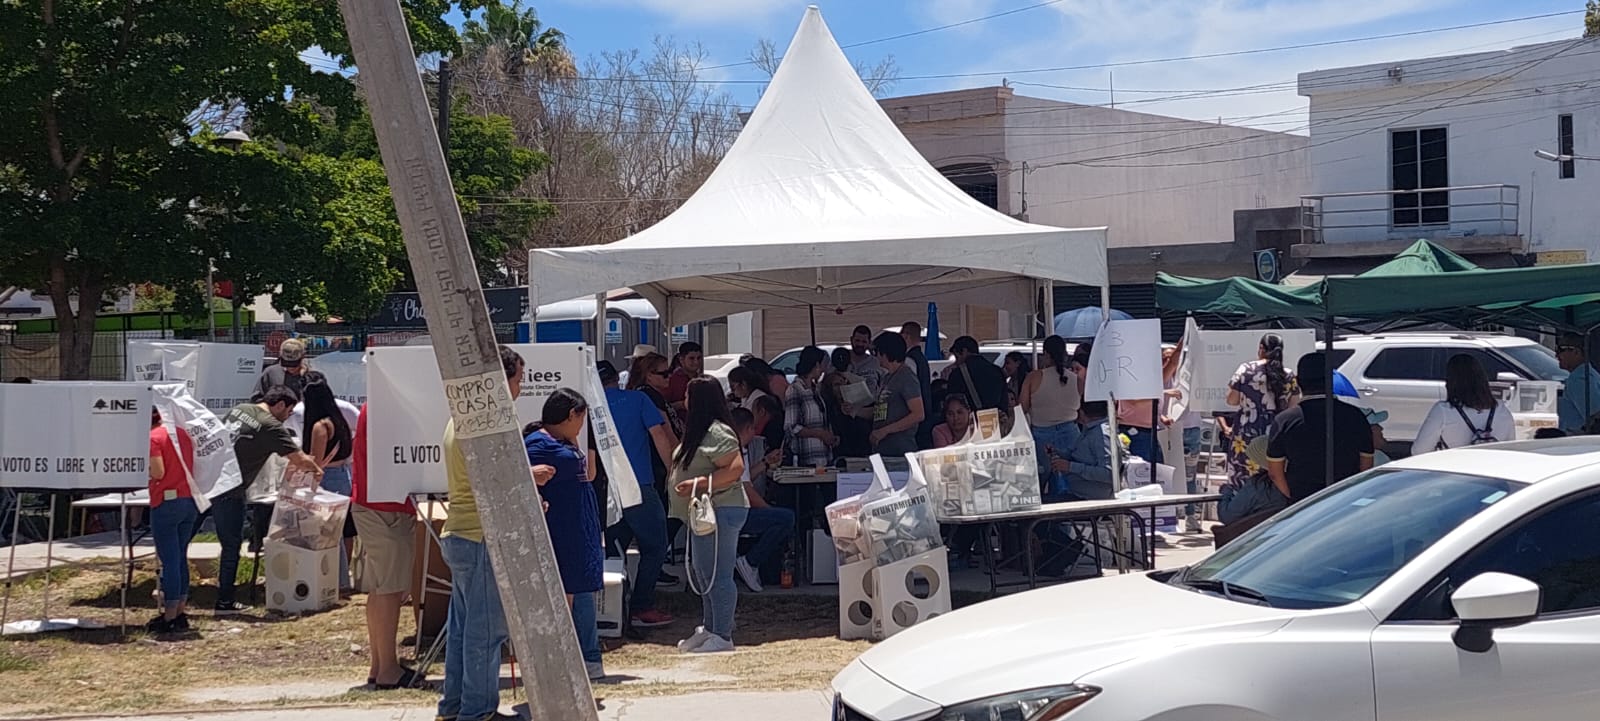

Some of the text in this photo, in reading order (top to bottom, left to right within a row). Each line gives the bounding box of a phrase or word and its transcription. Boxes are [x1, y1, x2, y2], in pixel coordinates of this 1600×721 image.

[1107, 331, 1124, 347] 3
[528, 369, 562, 382] iees
[446, 377, 495, 400] COMPRO
[110, 399, 138, 411] INE
[456, 393, 498, 414] CASA
[393, 445, 441, 464] EL VOTO
[974, 447, 1031, 461] SENADORES
[3, 457, 145, 473] VOTO ES LIBRE Y SECRETO
[871, 495, 926, 516] AYUNTAMIENTO
[1020, 495, 1040, 504] INE
